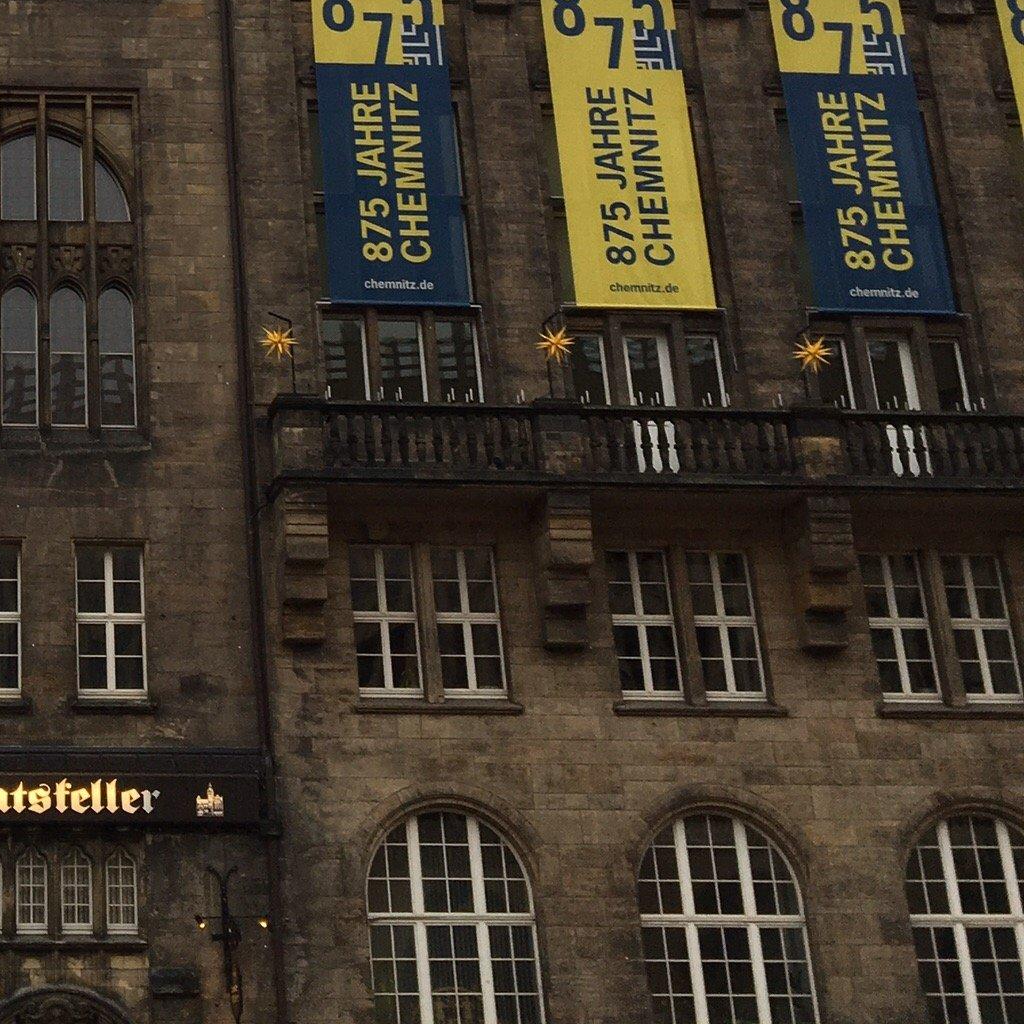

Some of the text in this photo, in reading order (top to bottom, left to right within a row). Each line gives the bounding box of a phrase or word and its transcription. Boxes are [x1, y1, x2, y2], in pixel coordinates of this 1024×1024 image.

[351, 82, 394, 263] 875 JAHRE
[387, 83, 432, 264] CHEMNITZ
[585, 86, 637, 266] 875 JAHRE
[622, 87, 676, 267] CHEMNITZ
[816, 91, 877, 271] 875 JAHRE
[854, 92, 915, 272] CHEMNITZ
[364, 278, 434, 292] chemnitz.de
[609, 281, 680, 294] chemnitz.de
[849, 286, 919, 300] chemnitz.de
